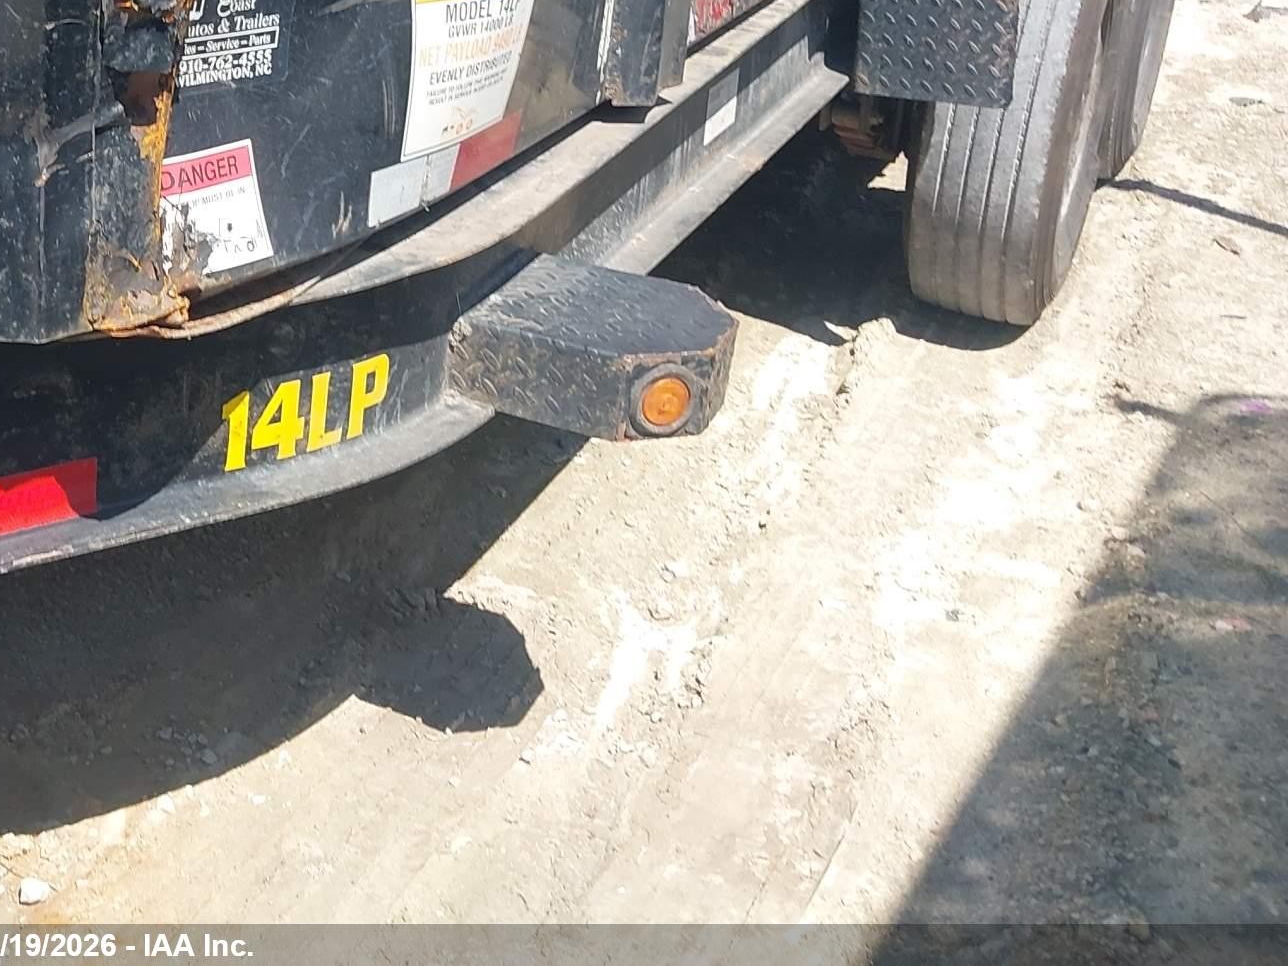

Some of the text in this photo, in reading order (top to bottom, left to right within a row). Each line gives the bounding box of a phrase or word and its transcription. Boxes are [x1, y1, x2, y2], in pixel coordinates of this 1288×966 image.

[445, 0, 493, 24] MODEL
[188, 12, 280, 38] utos & Trailers
[448, 21, 478, 40] GVWR
[206, 39, 239, 53] Service
[249, 34, 271, 47] Parts
[419, 45, 441, 68] NET
[446, 33, 492, 63] PAYLOAD
[255, 62, 273, 77] NC
[429, 66, 465, 86] EVENLY
[160, 155, 239, 192] DANGER
[222, 353, 390, 472] 14LP
